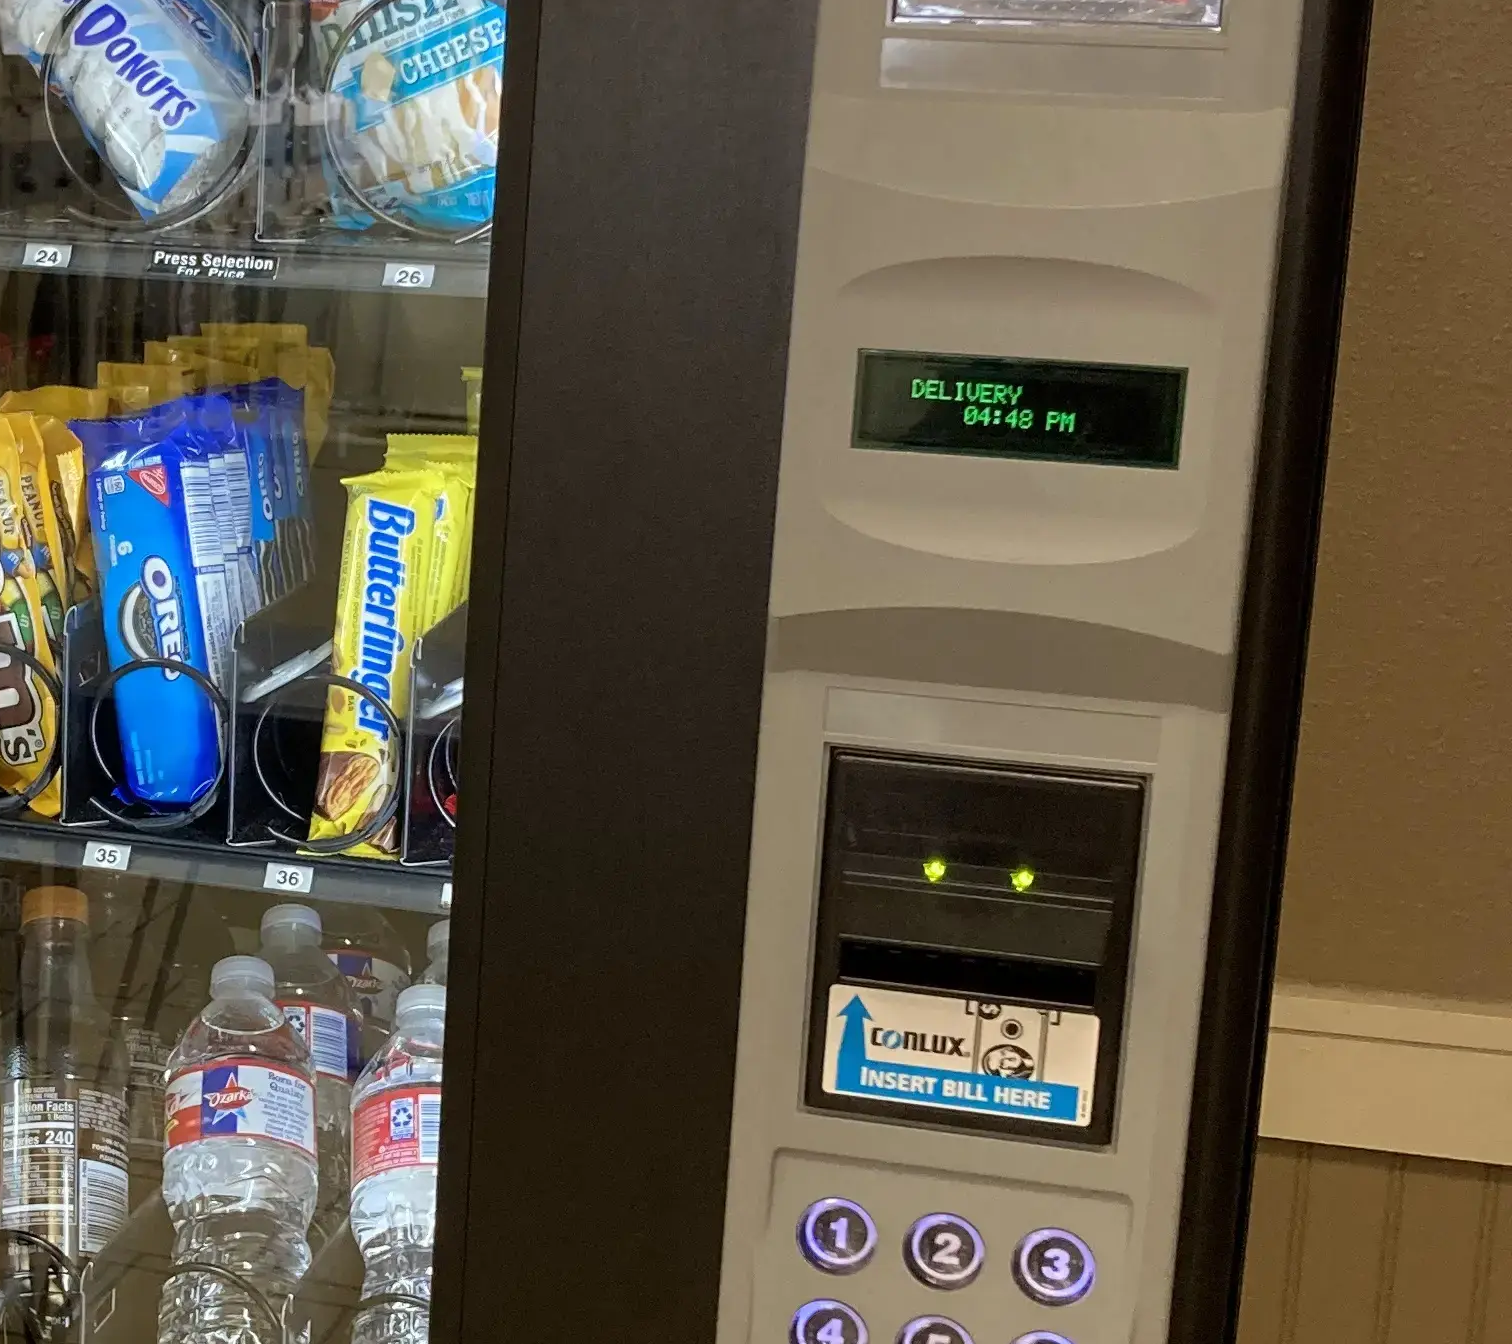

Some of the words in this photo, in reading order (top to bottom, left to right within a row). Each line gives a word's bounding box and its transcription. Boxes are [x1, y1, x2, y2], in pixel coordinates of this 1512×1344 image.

[74, 4, 197, 127] DONUTS
[399, 18, 504, 84] CHEESE
[36, 250, 58, 264] 24
[154, 252, 196, 266] Press
[202, 254, 274, 270] Selection
[398, 270, 421, 285] 26
[910, 377, 1023, 406] DELIVERY
[963, 406, 1033, 430] 04:48
[1045, 411, 1076, 433] PM
[21, 475, 44, 530] PEANUT
[142, 557, 181, 682] OREO
[360, 498, 415, 742] Butterfinger
[95, 848, 117, 864] 35
[277, 870, 299, 885] 36
[860, 1066, 937, 1095] INSERT
[942, 1079, 988, 1102] BILL
[993, 1086, 1052, 1110] HERE
[46, 1101, 74, 1112] Facts
[45, 1130, 74, 1145] 240
[829, 1217, 849, 1248] 1
[931, 1232, 962, 1265] 2
[1041, 1248, 1070, 1280] 3
